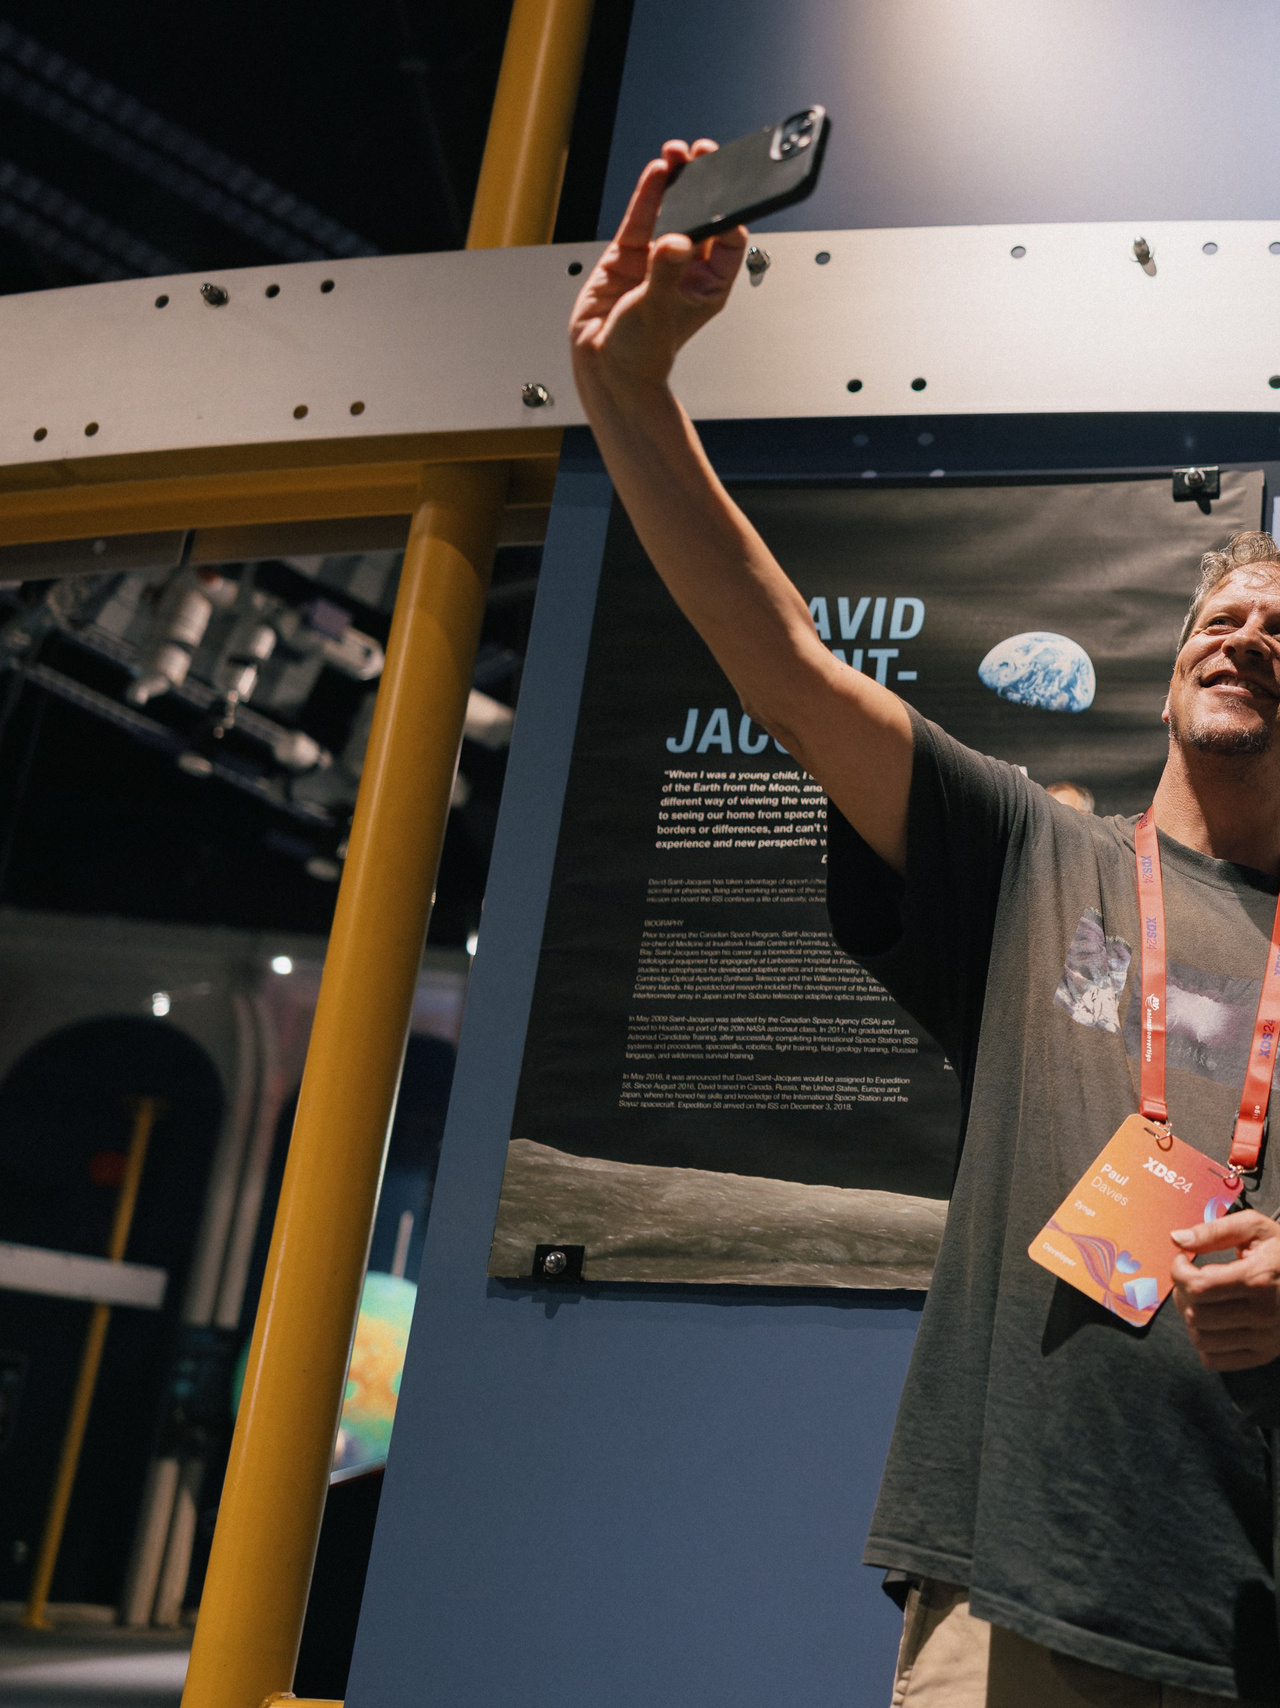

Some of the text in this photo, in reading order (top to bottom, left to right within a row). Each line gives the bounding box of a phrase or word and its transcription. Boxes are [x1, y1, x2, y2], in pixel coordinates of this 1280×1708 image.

[808, 597, 925, 640] AVID
[662, 783, 673, 792] of
[674, 783, 691, 792] the
[693, 782, 721, 792] Earth
[723, 783, 747, 792] from
[749, 783, 766, 792] the
[768, 783, 801, 793] Moon,
[664, 770, 698, 779] “When
[699, 770, 704, 779] I
[737, 772, 770, 781] young
[772, 771, 800, 781] child,
[802, 771, 807, 780] I
[660, 797, 702, 806] different
[704, 798, 725, 807] way
[726, 796, 738, 805] of
[739, 796, 779, 807] viewing
[781, 796, 798, 805] the
[658, 811, 669, 820] to
[671, 810, 705, 822] seeing
[706, 812, 724, 820] our
[726, 810, 755, 820] home
[757, 809, 782, 819] from
[784, 811, 815, 821] space
[657, 825, 696, 834] borders
[698, 826, 710, 834] or
[711, 824, 771, 834] differences,
[773, 823, 794, 833] and
[795, 823, 821, 833] can't
[655, 839, 711, 850] experience
[713, 838, 733, 848] and
[734, 840, 756, 848] new
[757, 837, 817, 849] perspective
[1141, 855, 1154, 884] XDS24
[1146, 917, 1157, 950] XDS24
[1258, 1019, 1275, 1059] XDS24
[1100, 1163, 1129, 1187] Paul
[1141, 1156, 1193, 1194] XDS24
[1090, 1175, 1129, 1207] Davies
[1073, 1199, 1096, 1217] Zynga
[1042, 1241, 1077, 1268] Developer
